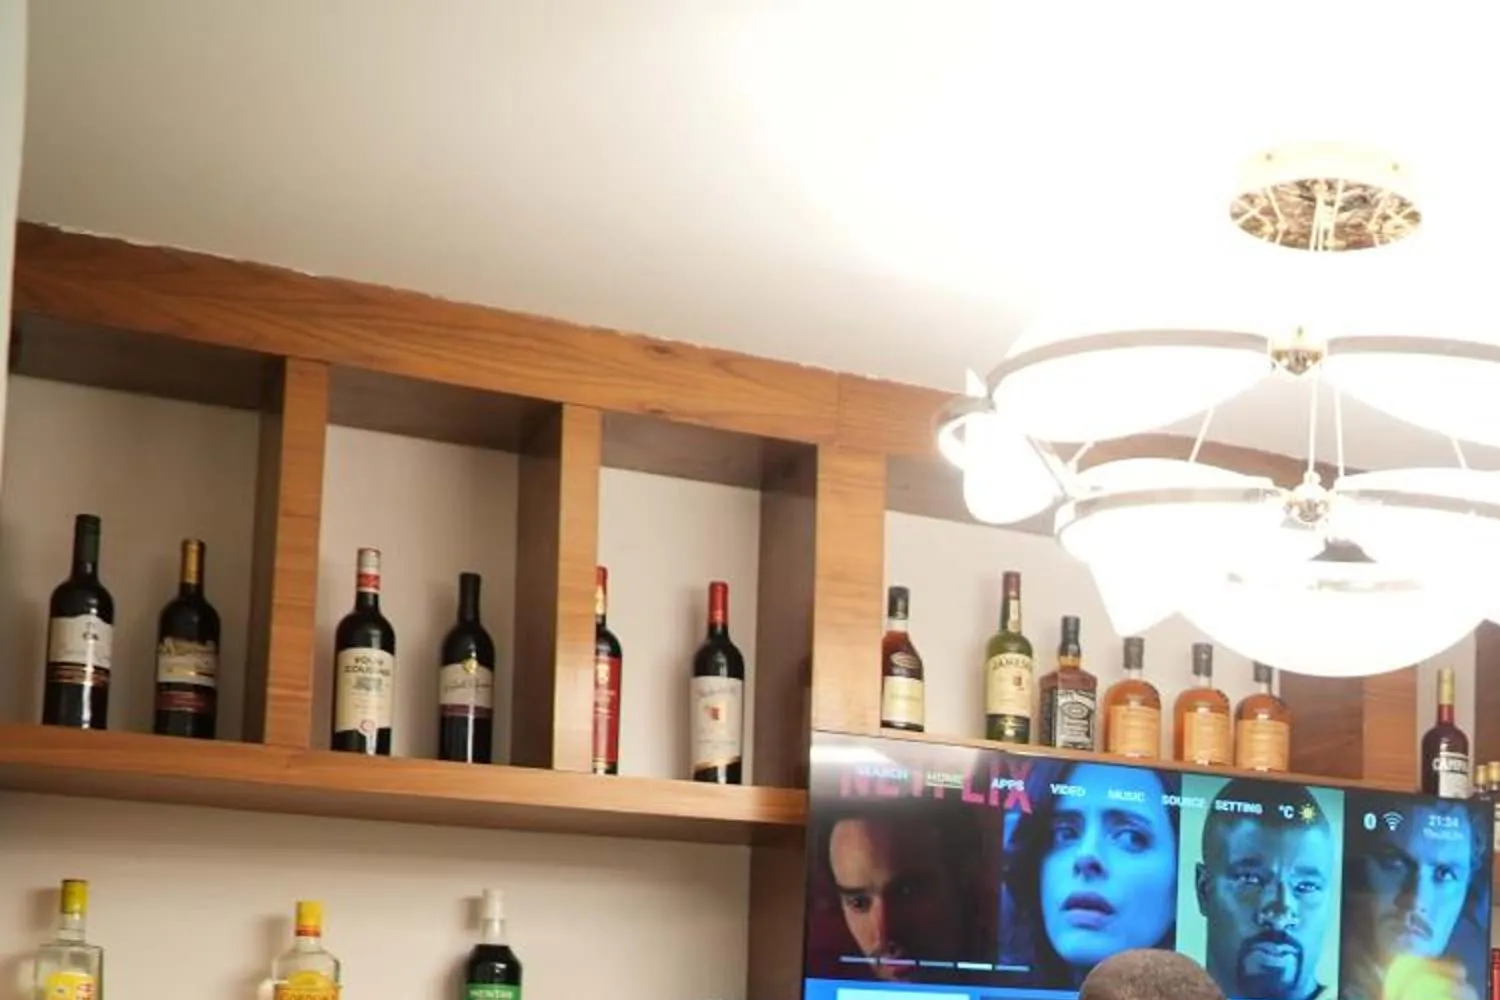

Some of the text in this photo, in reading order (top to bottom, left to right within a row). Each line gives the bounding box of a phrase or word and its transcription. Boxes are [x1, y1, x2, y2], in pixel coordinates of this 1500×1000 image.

[991, 777, 1025, 792] APPS
[1050, 783, 1086, 799] VIDEO
[1108, 788, 1146, 803] MUSIC
[1161, 794, 1206, 810] SOURCE
[1215, 799, 1264, 815] SETTING
